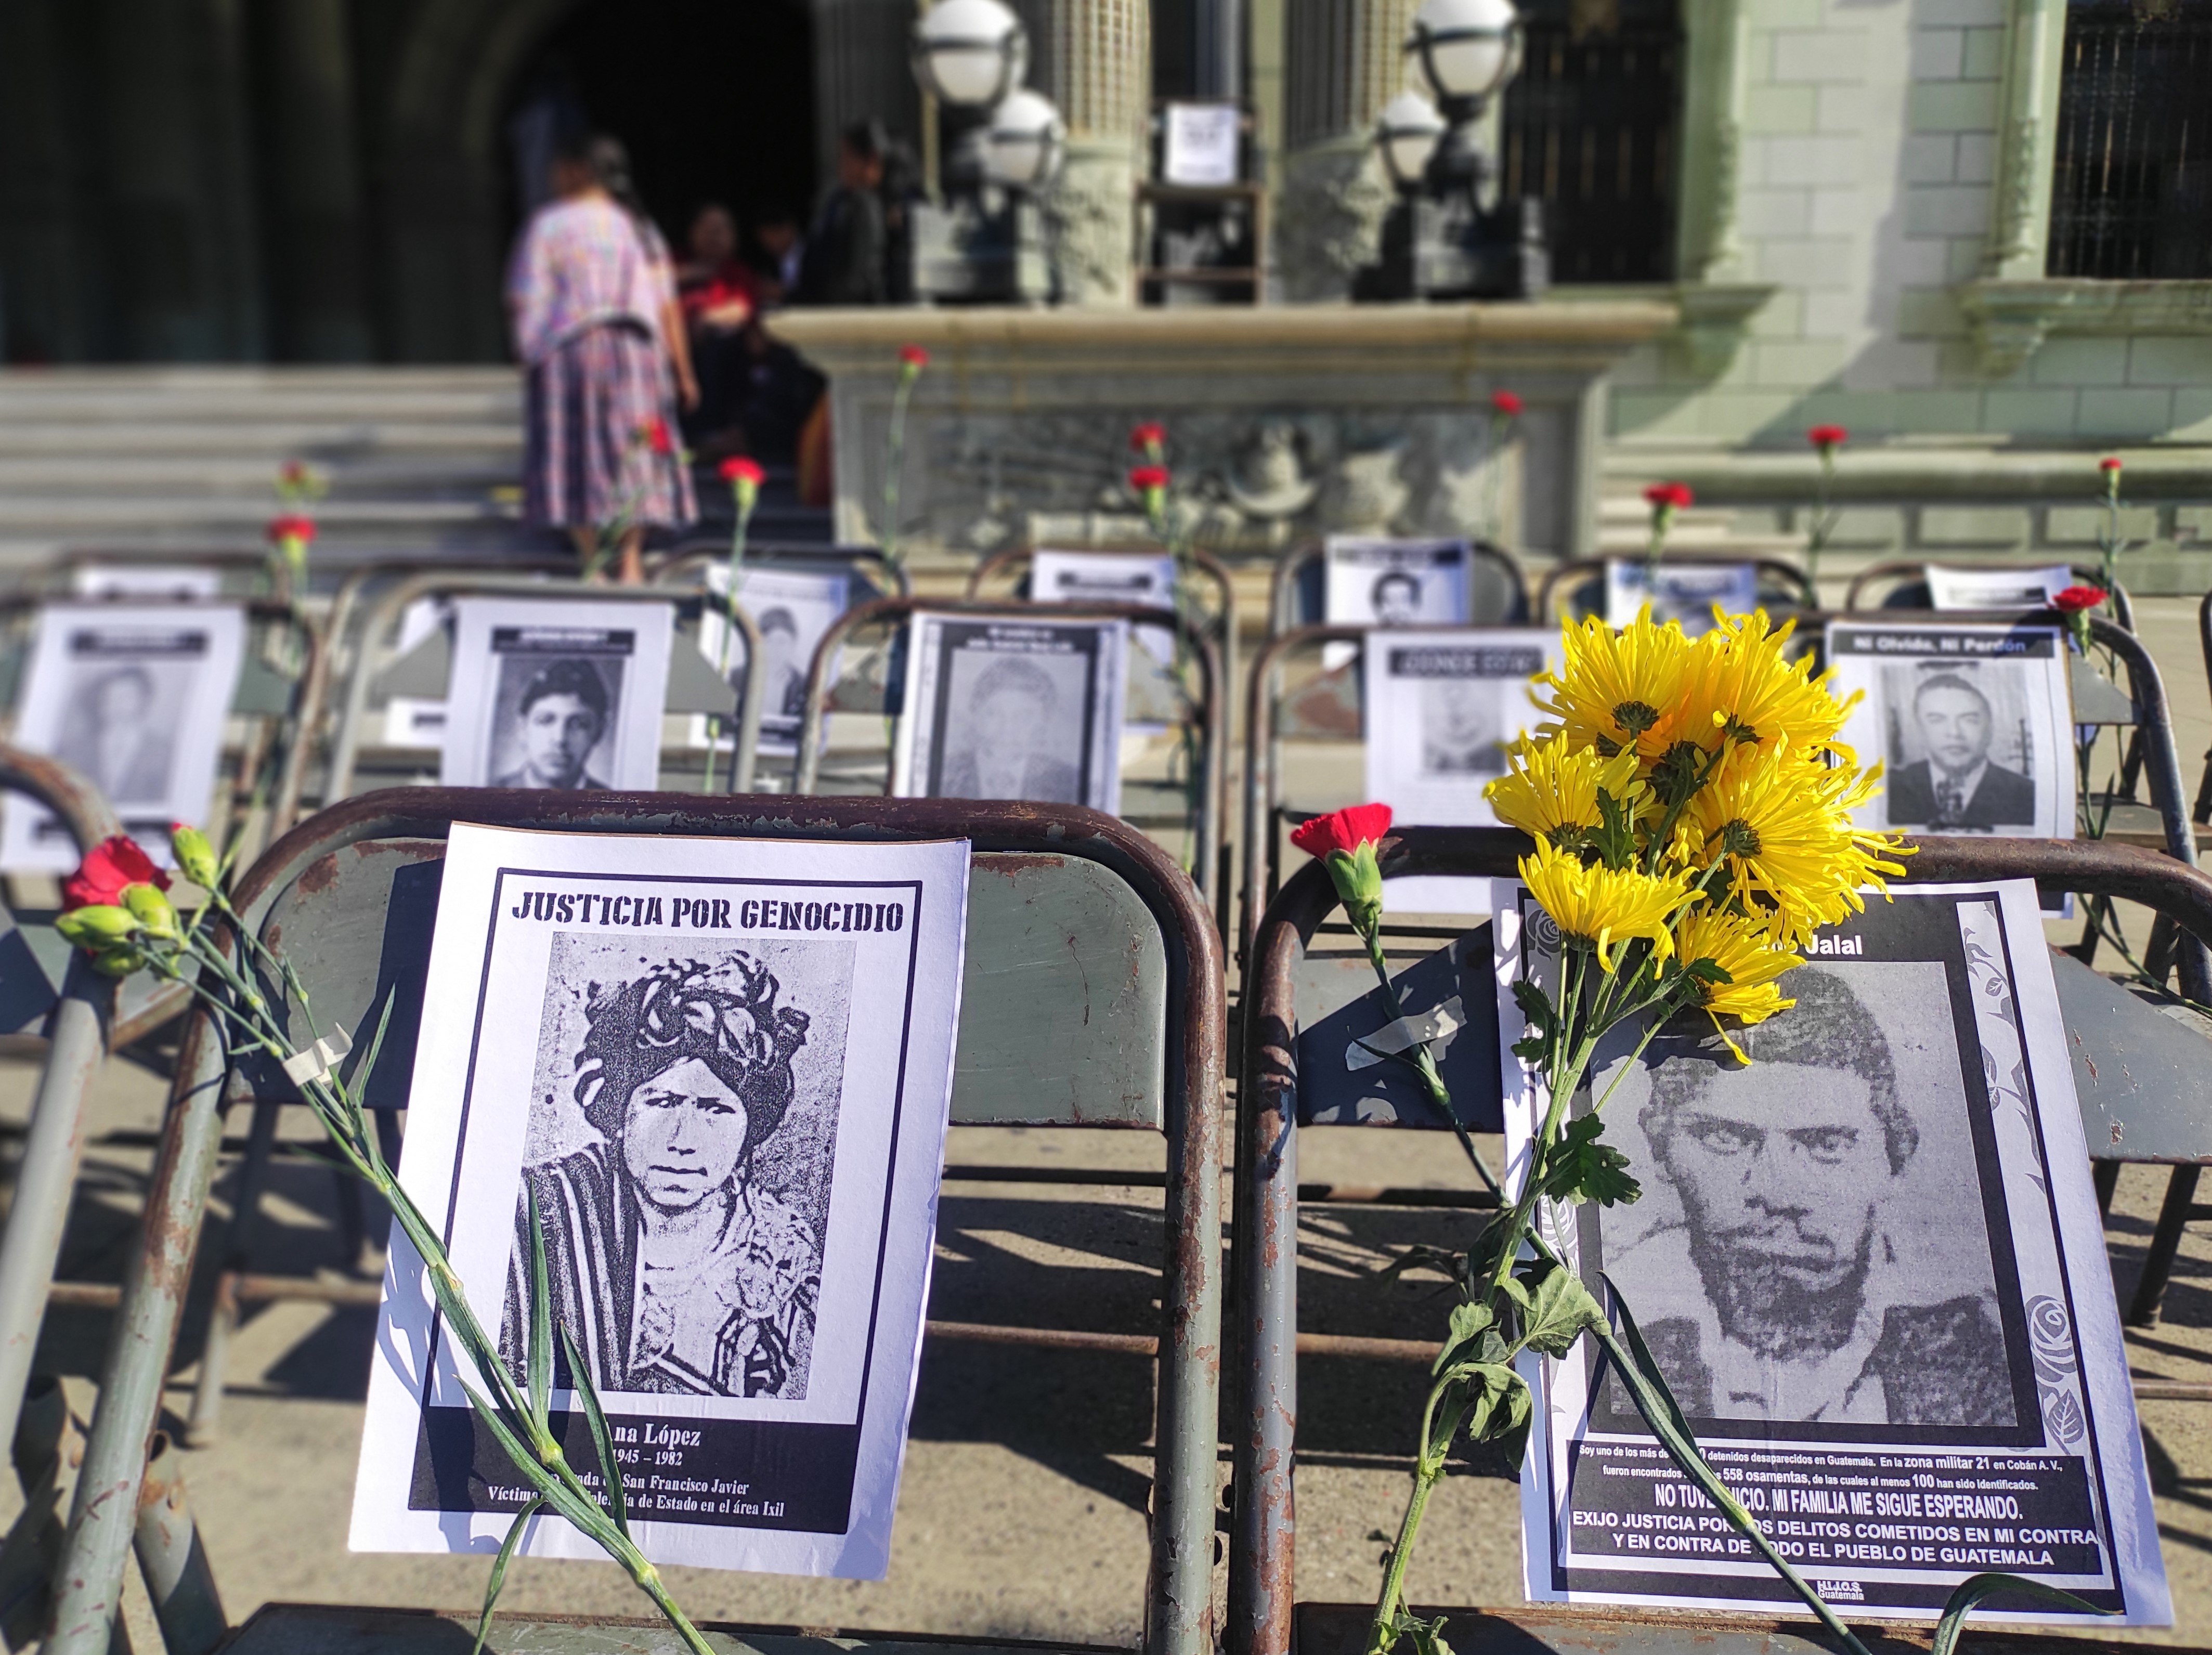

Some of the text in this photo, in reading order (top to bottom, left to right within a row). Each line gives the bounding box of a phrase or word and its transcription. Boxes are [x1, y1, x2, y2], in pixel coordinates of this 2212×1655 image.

[512, 892, 903, 932] JUSTICIA POR GENOCIDIO
[1804, 934, 1863, 955] Jalal
[605, 1422, 701, 1450] na López
[655, 1451, 683, 1466] 1982
[1579, 1444, 1595, 1457] Soy
[1596, 1448, 1612, 1456] uno
[1613, 1446, 1624, 1456] de
[1625, 1447, 1638, 1457] los
[1639, 1448, 1657, 1458] más
[1707, 1450, 1749, 1463] detenidos
[1750, 1452, 1813, 1465] desaparecidos
[1814, 1456, 1826, 1465] en
[1827, 1455, 1876, 1467] Guatemala.
[1880, 1456, 1893, 1467] En
[1894, 1457, 1903, 1467] la
[1903, 1457, 1933, 1468] zona
[1935, 1455, 1974, 1469] militar
[1975, 1456, 1990, 1469] 21
[1993, 1462, 2006, 1470] en
[2007, 1459, 2037, 1470] Cobán
[2038, 1460, 2049, 1470] A.
[622, 1473, 645, 1489] San
[650, 1475, 708, 1492] Francisco
[711, 1479, 749, 1495] Javier
[1603, 1464, 1630, 1476] fueron
[1630, 1467, 1683, 1479] encontrados
[1722, 1468, 1743, 1482] 558
[1745, 1470, 1811, 1486] osamentas,
[1812, 1474, 1824, 1484] de
[1825, 1474, 1839, 1485] las
[1840, 1475, 1869, 1486] cuales
[1870, 1476, 1879, 1486] al
[1880, 1478, 1911, 1487] menos
[1912, 1474, 1935, 1488] 100
[1936, 1478, 1954, 1489] han
[1955, 1478, 1975, 1489] sido
[1976, 1479, 2039, 1490] identificados.
[638, 1493, 653, 1508] de
[656, 1494, 698, 1511] Estado
[700, 1501, 715, 1512] en
[719, 1499, 731, 1513] el
[733, 1500, 759, 1515] área
[762, 1501, 784, 1517] Ixil
[1655, 1483, 1676, 1507] NO
[1772, 1489, 1789, 1512] MI
[1790, 1489, 1847, 1515] FAMILIA
[1849, 1492, 1873, 1515] ME
[1875, 1492, 1922, 1517] SIGUE
[1924, 1494, 2023, 1520] ESPERANDO.
[1572, 1510, 1619, 1527] EXIJO
[1621, 1513, 1696, 1531] JUSTICIA
[1751, 1518, 1774, 1534] OS
[1777, 1520, 1851, 1537] DELITOS
[1855, 1523, 1960, 1542] COMETIDOS
[1964, 1527, 1990, 1542] EN
[1994, 1528, 2015, 1543] MI
[2019, 1528, 2099, 1545] CONTRA
[1612, 1533, 2054, 1565] Y EN CONTRA DE ODO EL PUEBLO DE GUATEMALA
[1817, 1588, 1865, 1600] Guatemala
